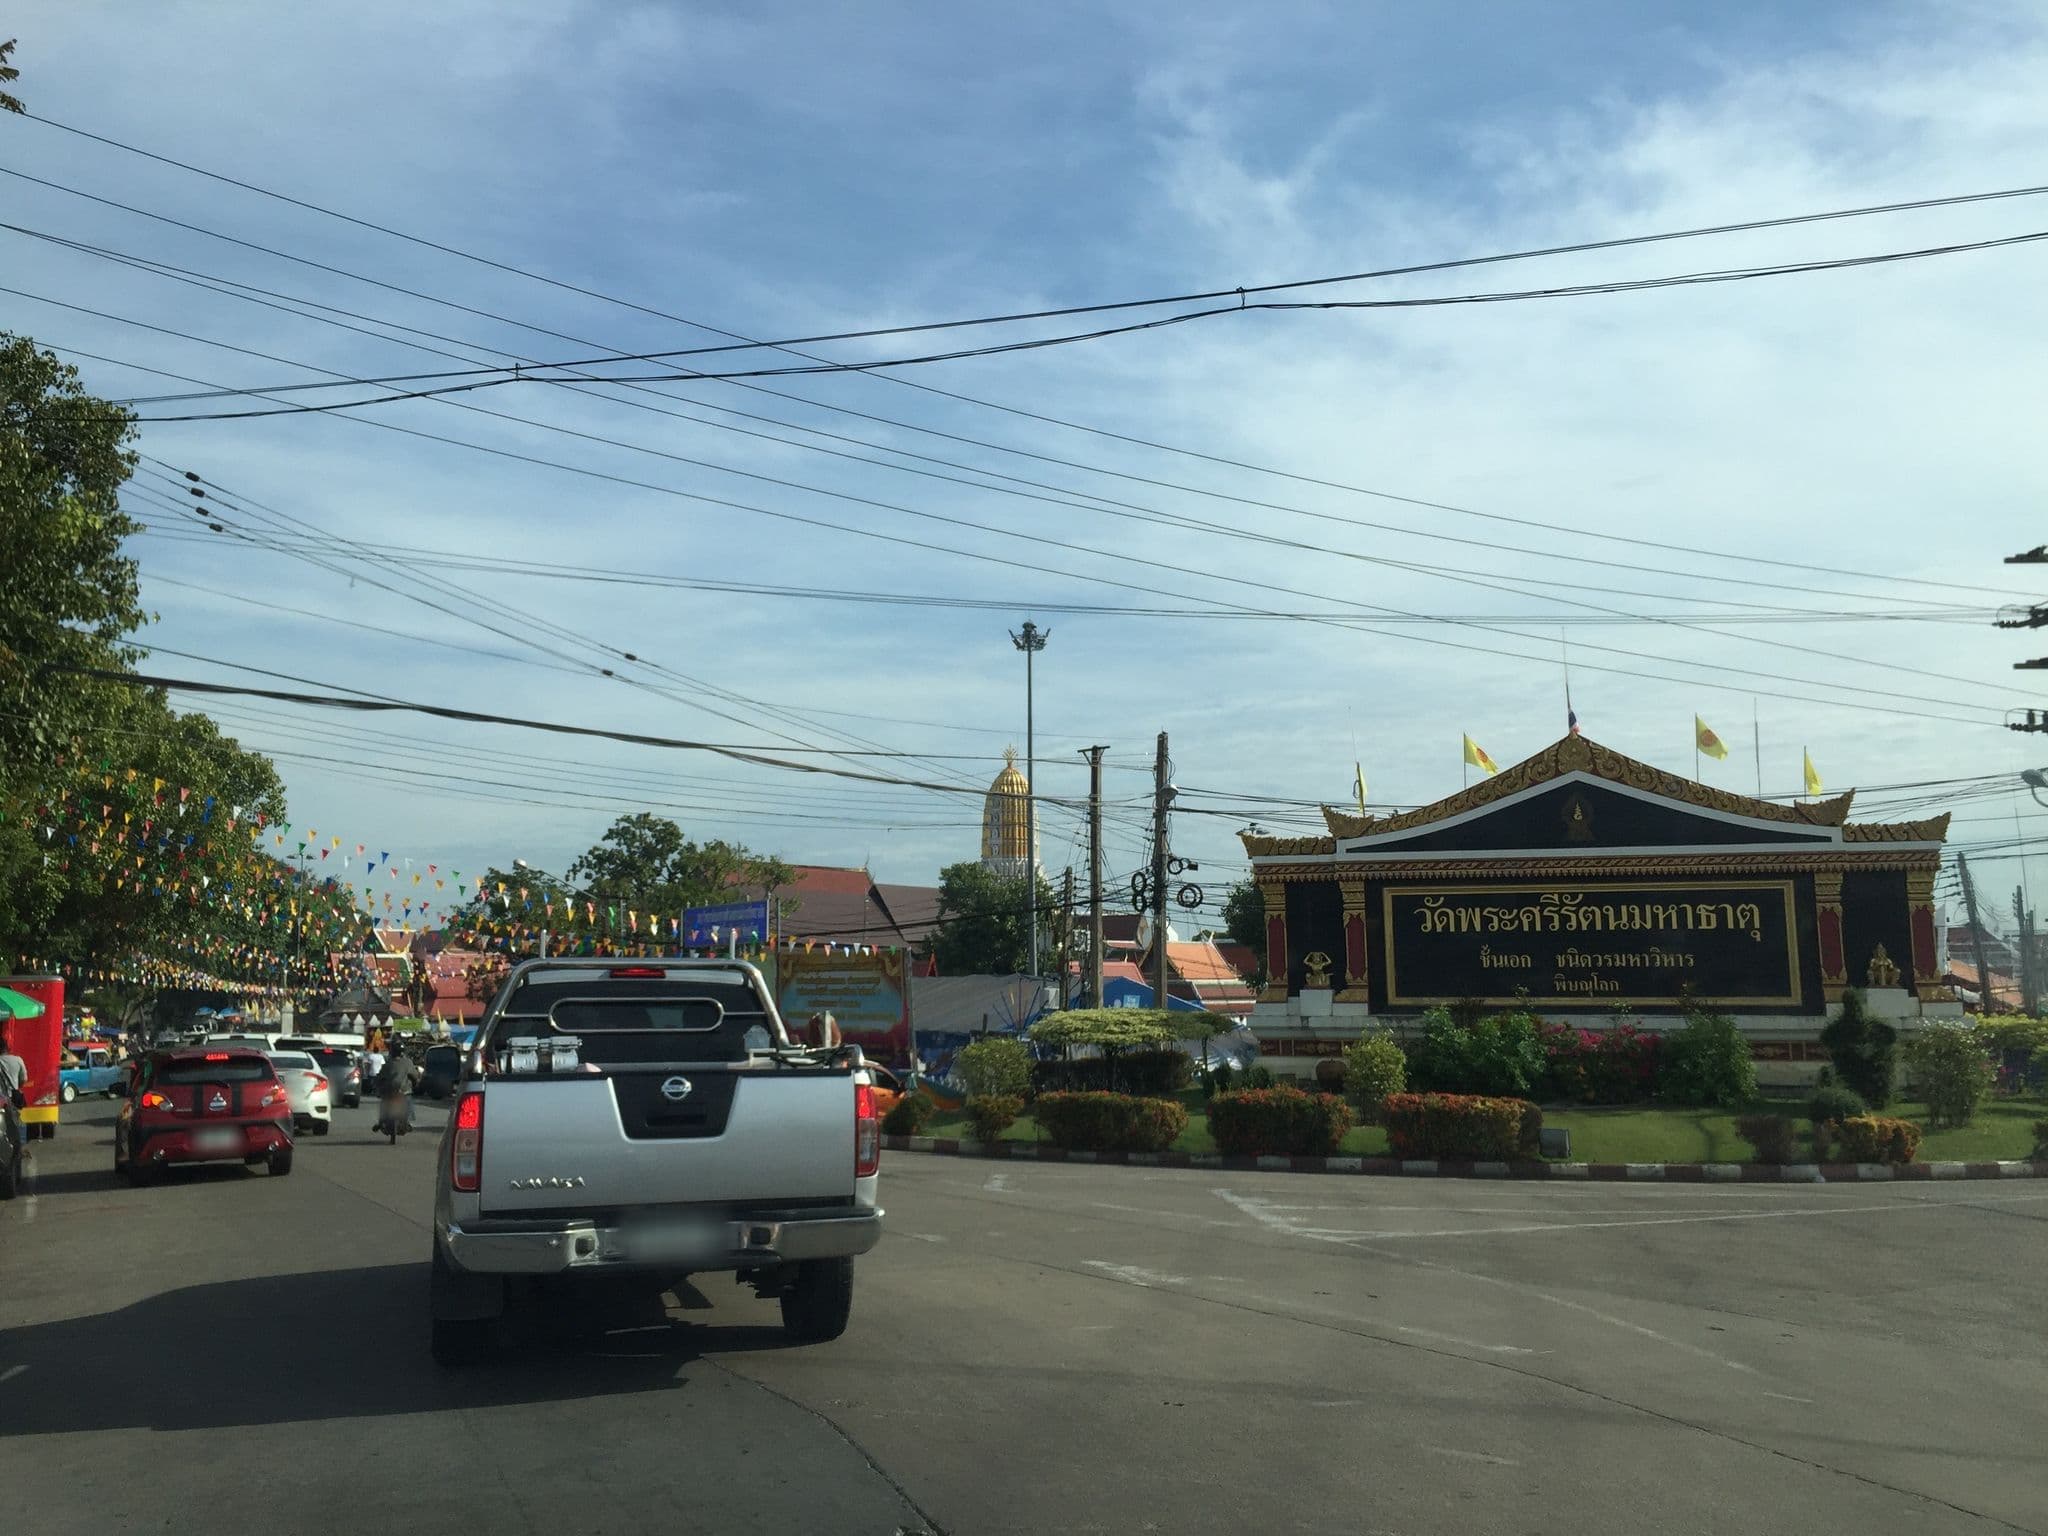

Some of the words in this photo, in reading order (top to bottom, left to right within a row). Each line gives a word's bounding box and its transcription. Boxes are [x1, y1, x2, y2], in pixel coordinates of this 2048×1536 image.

[1414, 893, 1761, 942] วัดพระศรีรัตนมหาธาตุ
[1479, 944, 1531, 969] ชั้นเอก
[1556, 947, 1695, 969] ชนิดวรมหาวิหาร
